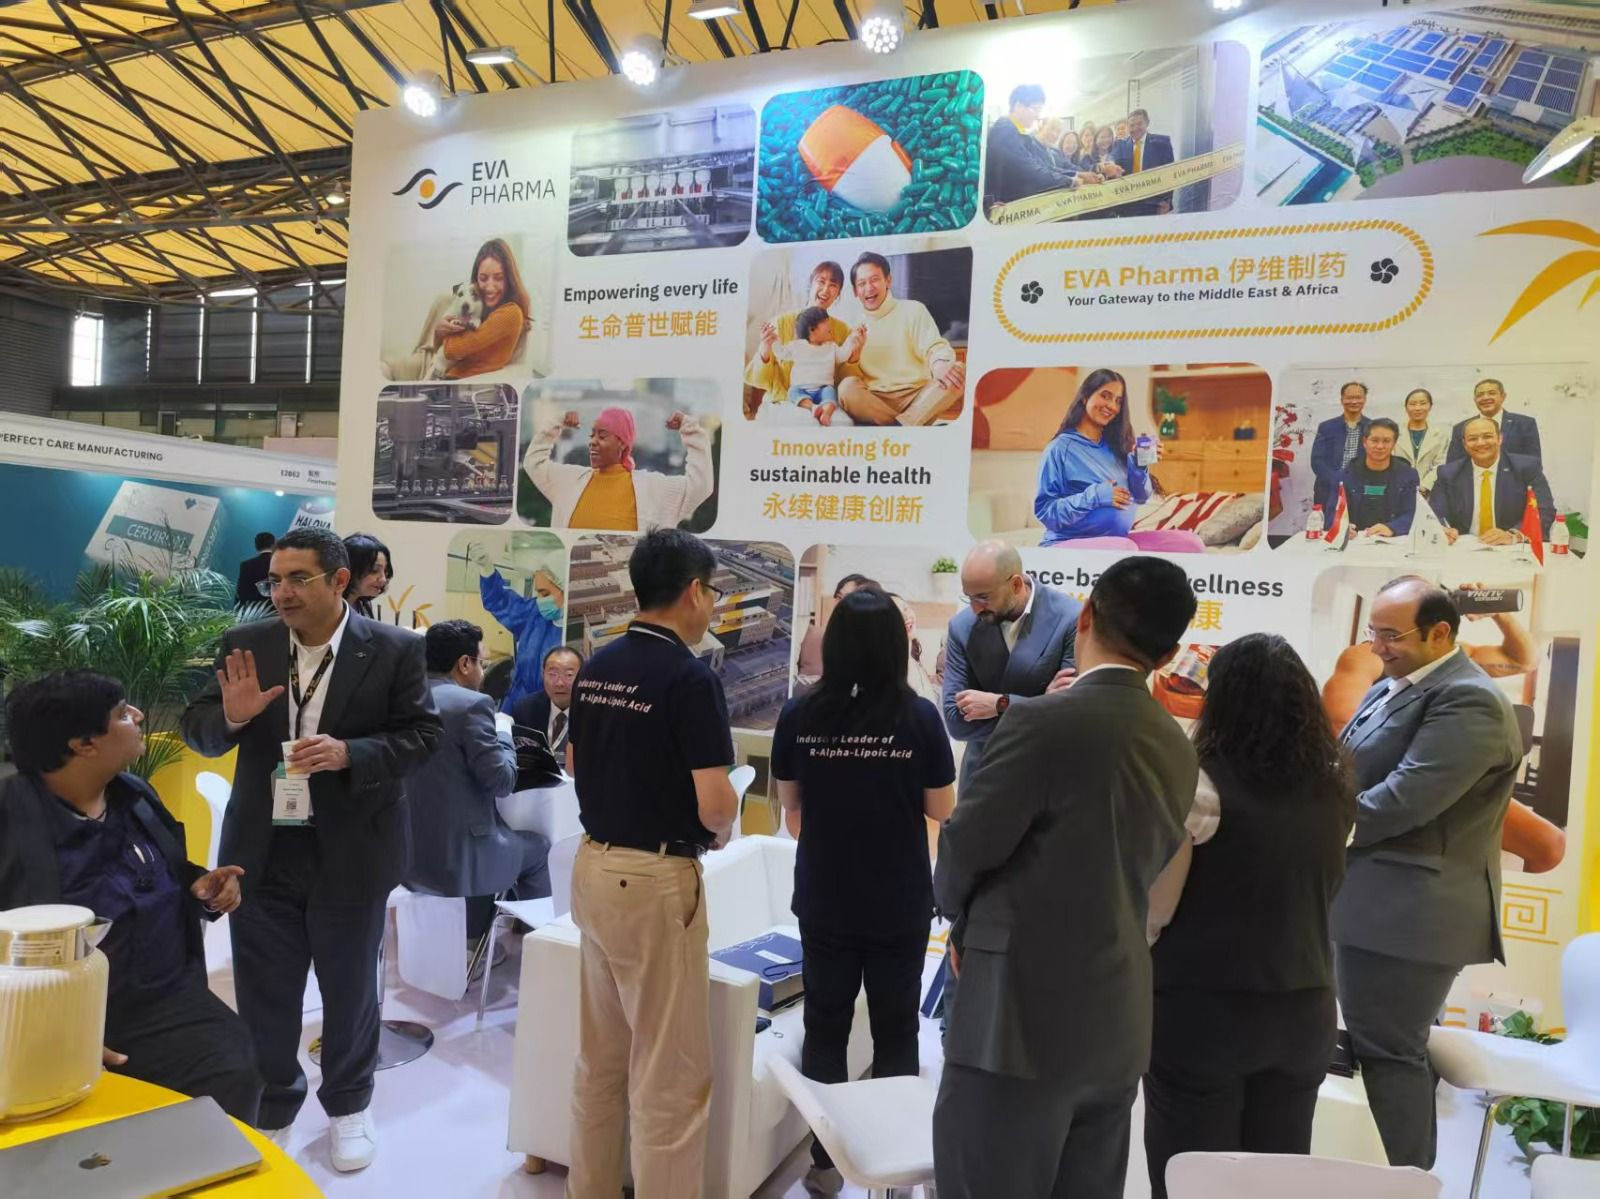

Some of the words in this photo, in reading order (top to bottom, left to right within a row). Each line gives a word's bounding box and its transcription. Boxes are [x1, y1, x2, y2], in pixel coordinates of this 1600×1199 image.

[471, 159, 509, 182] EVA
[470, 178, 557, 206] PHARMA
[998, 208, 1040, 225] PHARMA
[1114, 181, 1131, 195] EVA
[1130, 177, 1162, 191] PHARMA
[1063, 266, 1111, 290] EVA
[1118, 262, 1220, 288] Pharma
[1228, 252, 1348, 284] 伊维制药
[563, 283, 660, 304] Empowering
[663, 281, 708, 301] every
[711, 278, 739, 296] life
[1067, 293, 1096, 307] Your
[1098, 290, 1154, 308] Gateway
[1156, 289, 1171, 303] to
[1173, 288, 1195, 302] the
[1198, 286, 1245, 301] Middle
[1247, 284, 1278, 299] East
[1281, 284, 1293, 297] &
[1295, 282, 1339, 297] Africa
[578, 310, 718, 342] 生命普世赋能
[46, 438, 75, 451] CARE
[77, 441, 164, 462] MANUFACTURING
[771, 438, 877, 461] Innovating
[881, 437, 911, 458] for
[749, 465, 861, 485] sustainable
[866, 466, 932, 485] health
[762, 491, 924, 525] 永续健康创新
[1187, 574, 1283, 598] ellness
[603, 681, 626, 693] Leader
[626, 685, 640, 694] of
[627, 700, 653, 713] Acid
[796, 735, 838, 743] Indusy
[841, 735, 879, 744] Leader
[881, 735, 895, 744] of
[809, 748, 888, 759] R-Alpha-Lipoic
[889, 750, 913, 759] Acid
